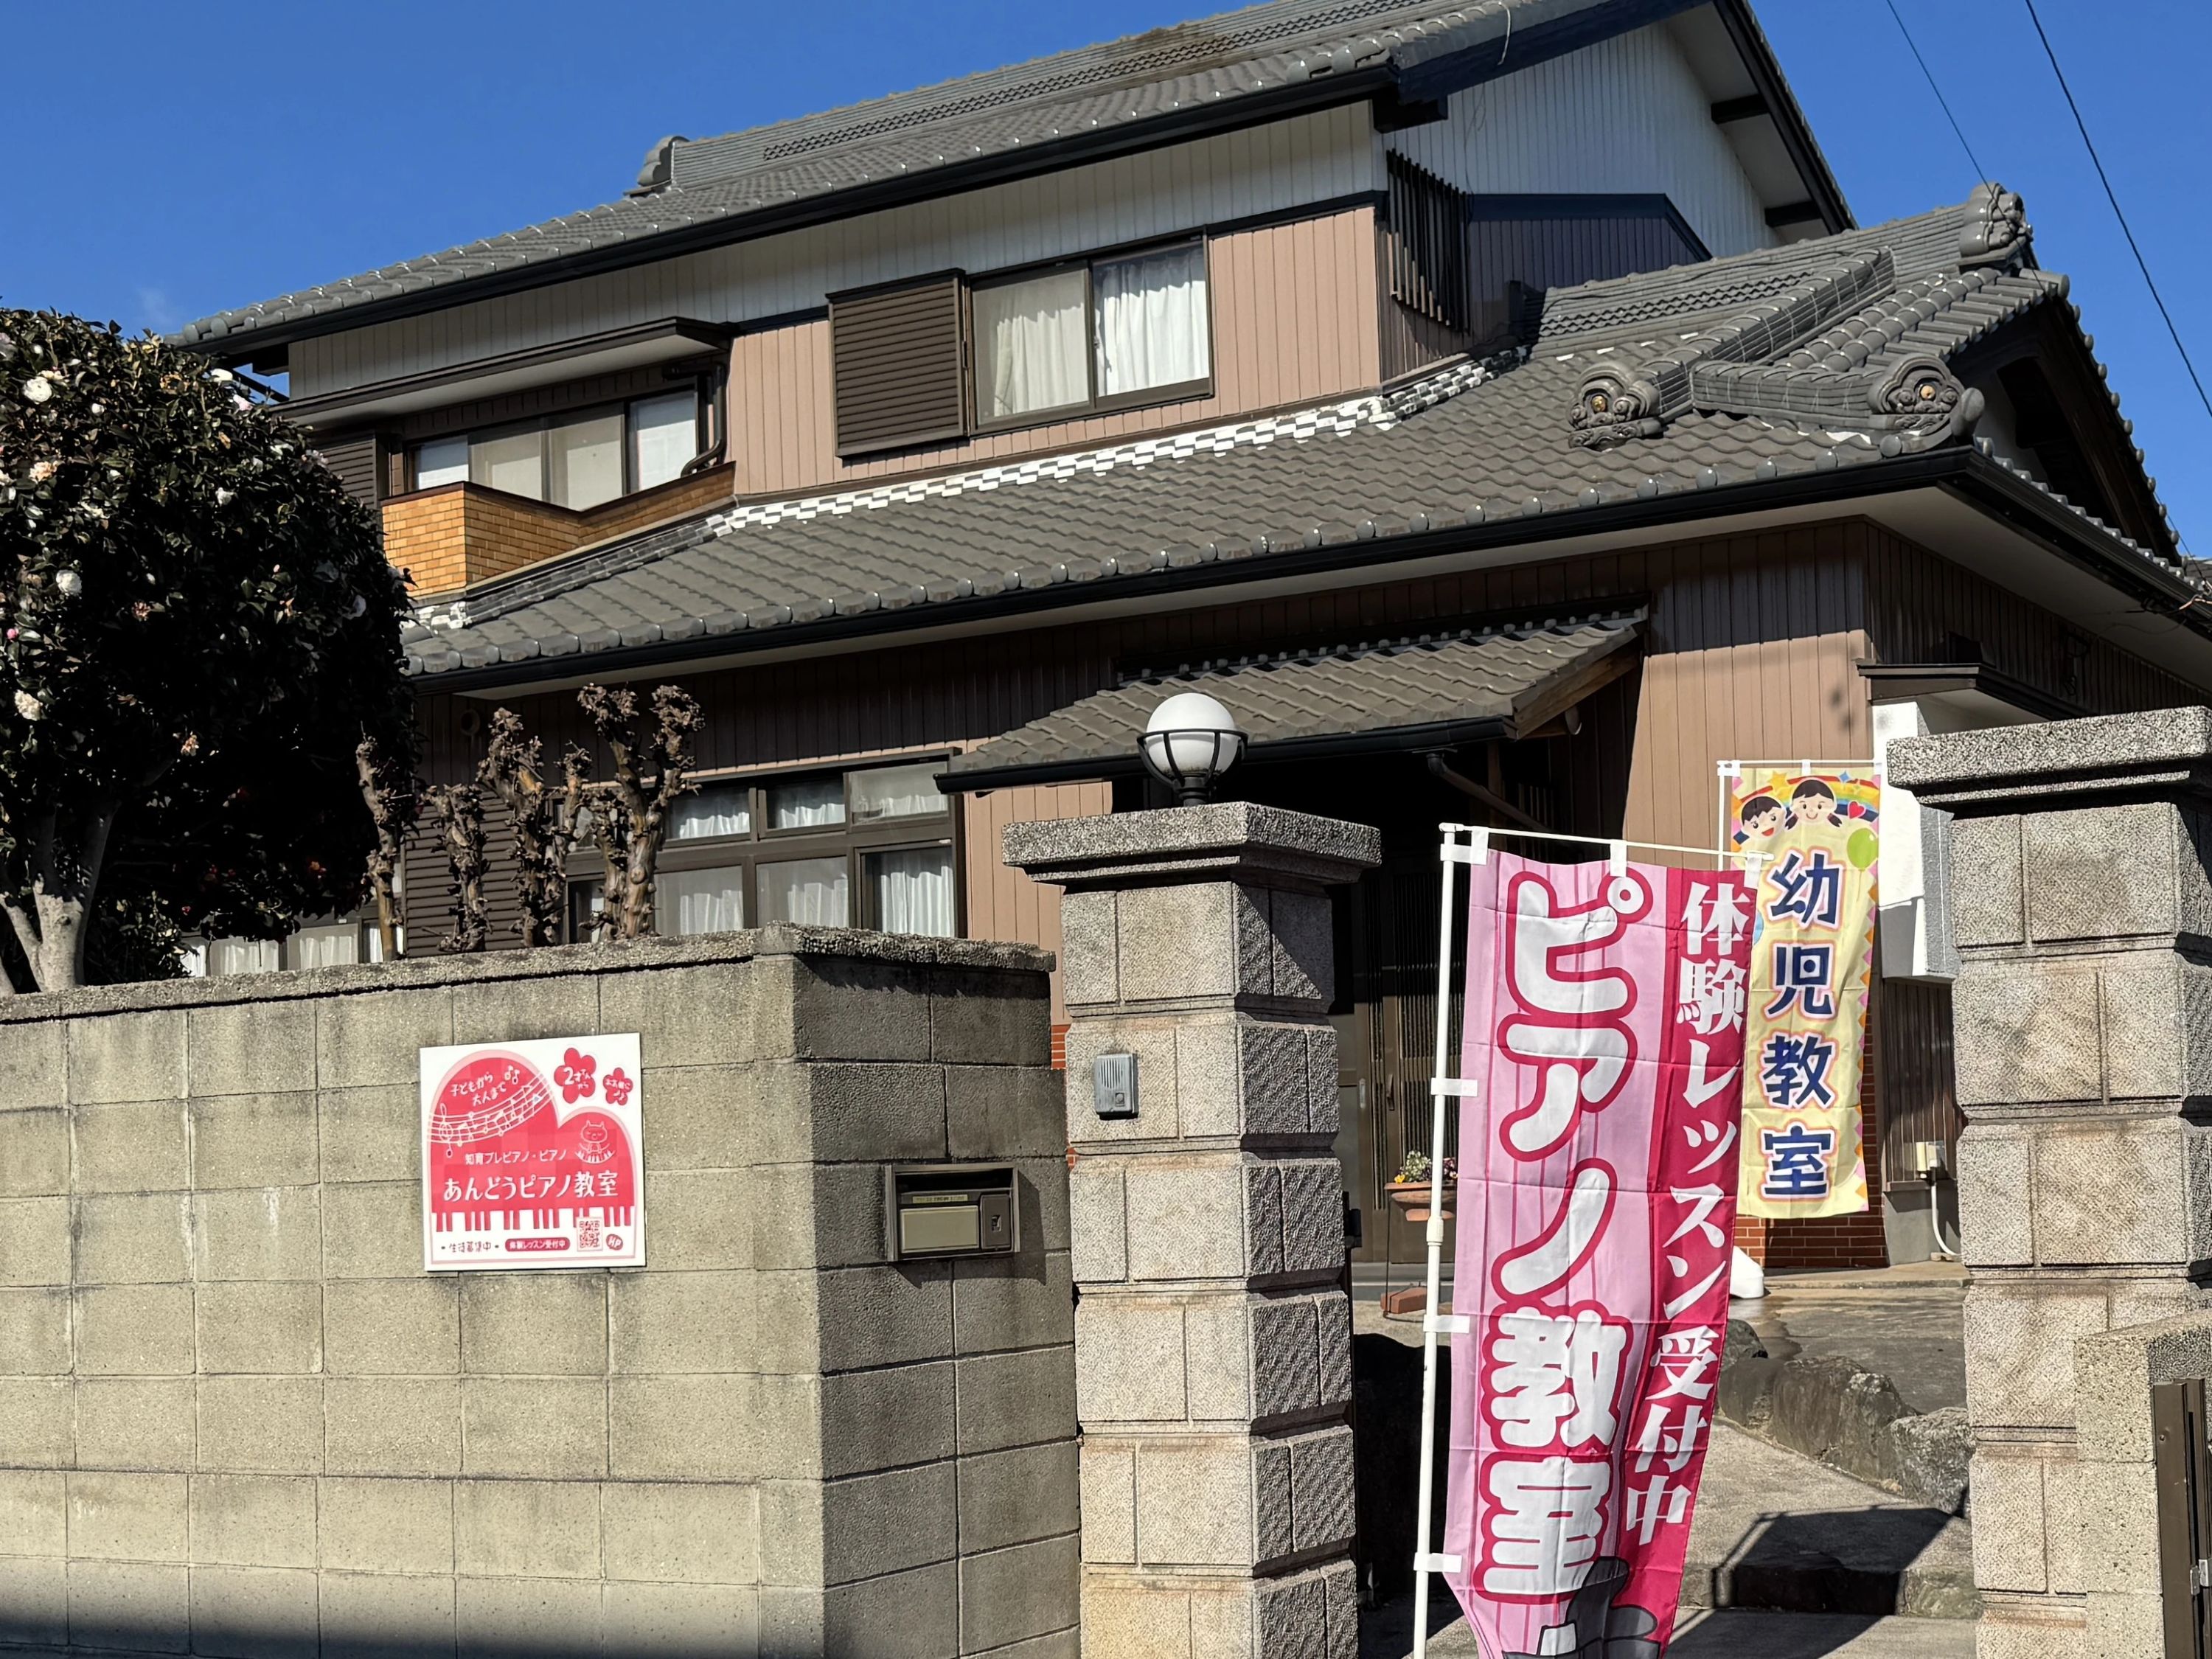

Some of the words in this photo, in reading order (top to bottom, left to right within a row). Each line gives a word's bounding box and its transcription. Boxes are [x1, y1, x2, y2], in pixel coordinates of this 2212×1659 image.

[451, 1071, 494, 1097] 子どもから
[1763, 852, 1840, 1199] 幼児教室
[443, 1169, 619, 1202] あんどうピアノ教室
[608, 1235, 622, 1248] HP
[1479, 872, 1648, 1599] ピアノ教室
[1626, 882, 1750, 1545] 体験レッスン受付中
